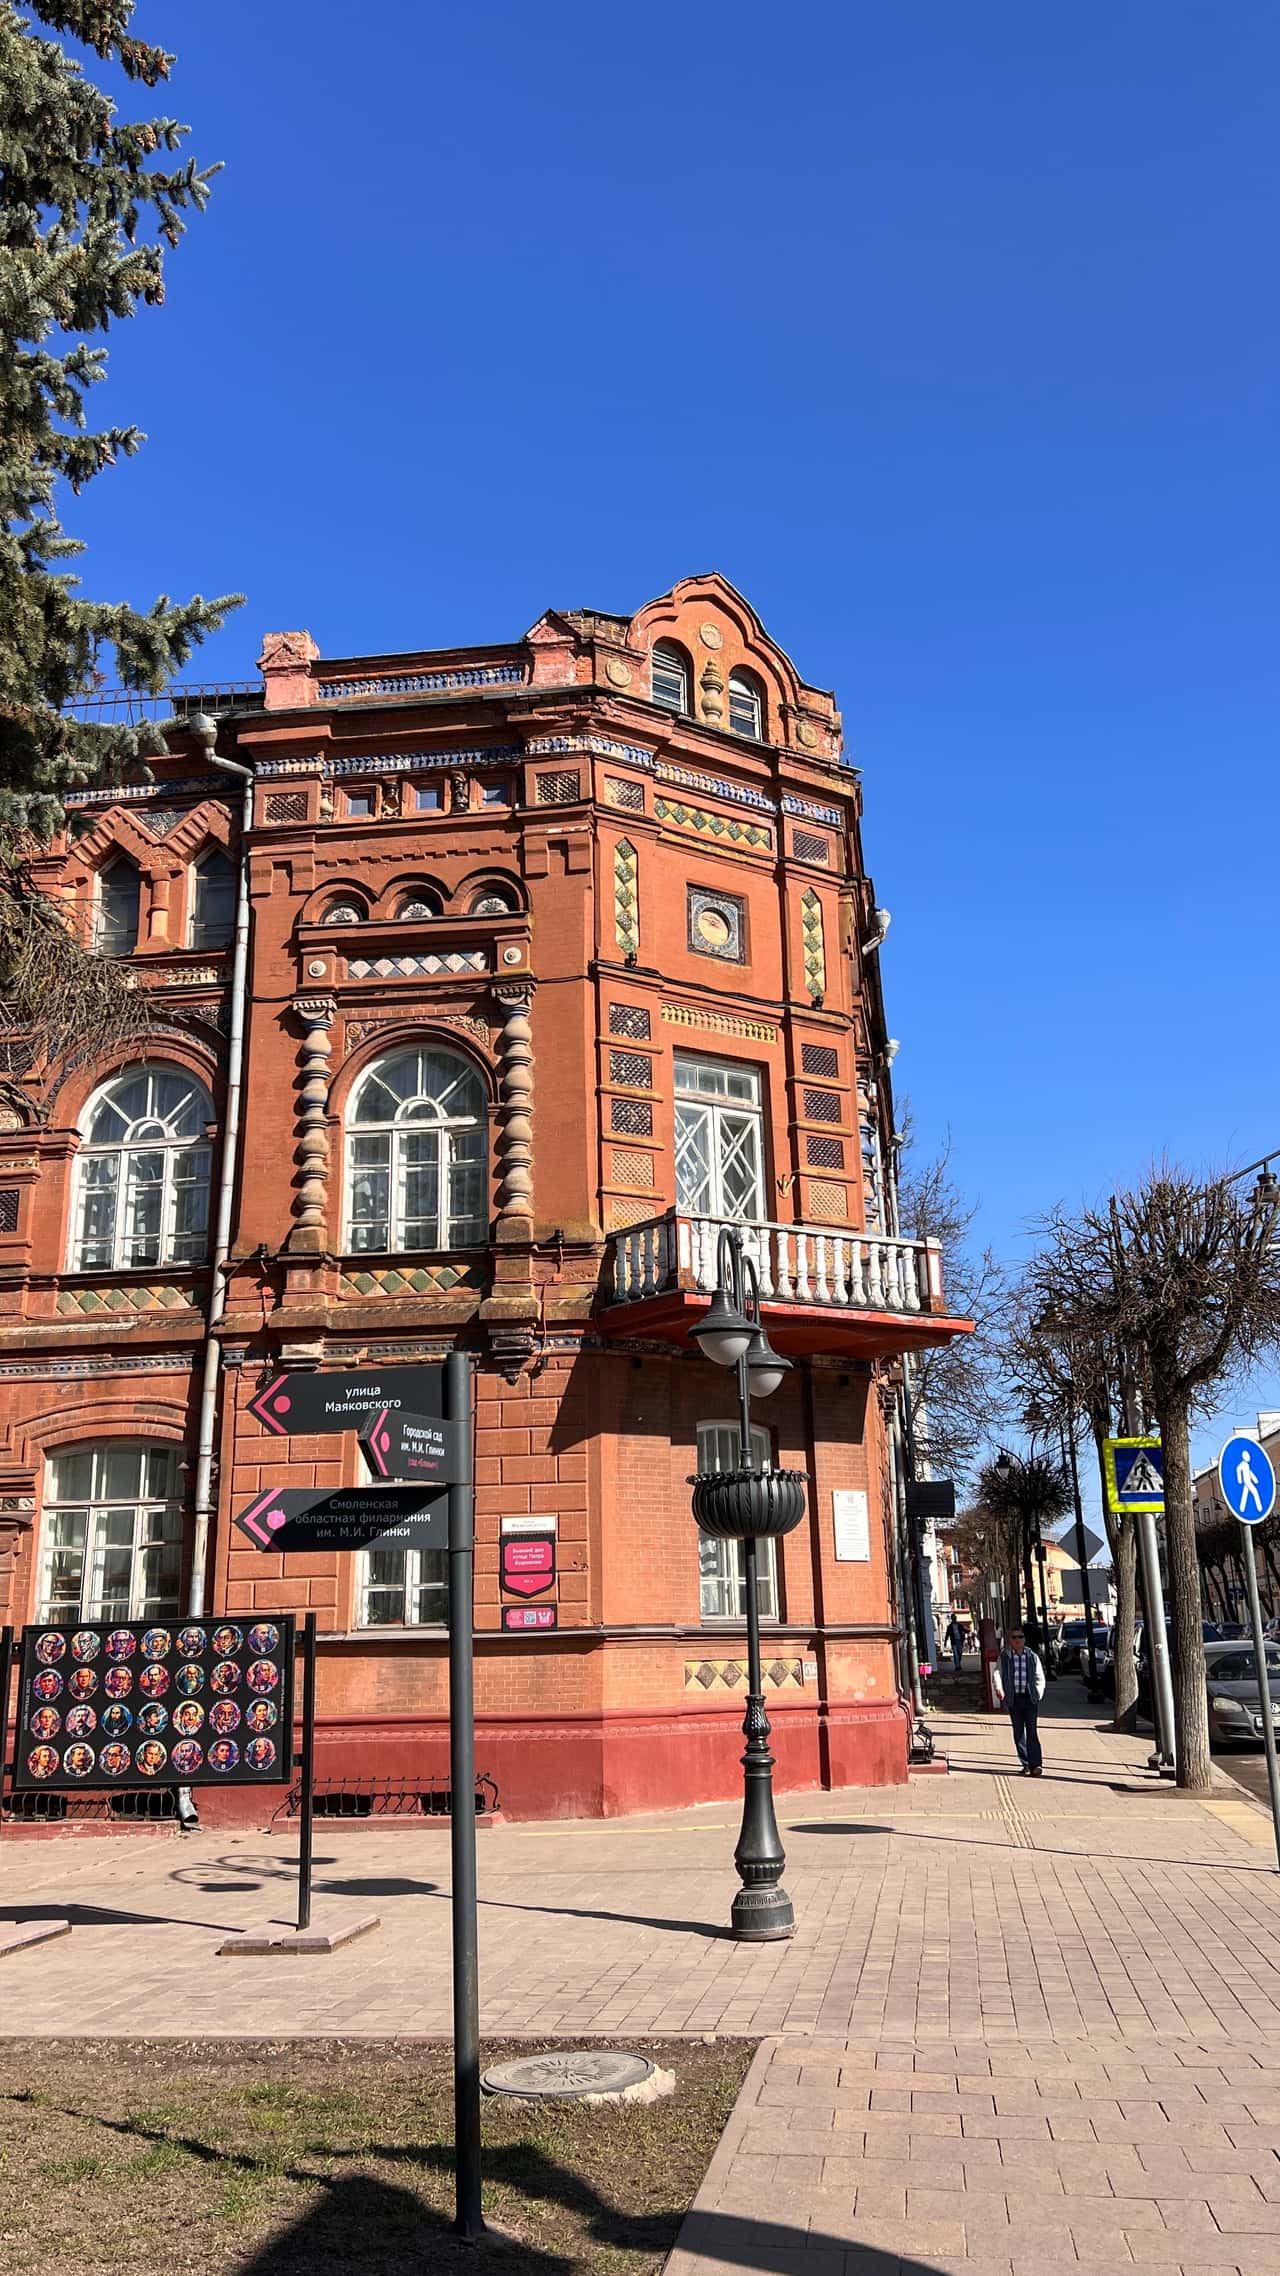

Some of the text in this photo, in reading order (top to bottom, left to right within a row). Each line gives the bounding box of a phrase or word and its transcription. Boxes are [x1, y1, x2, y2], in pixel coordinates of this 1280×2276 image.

[345, 1386, 381, 1399] улица
[325, 1399, 401, 1413] Маяковского
[403, 1424, 432, 1440] Городской
[329, 1499, 399, 1510] Смоленская
[295, 1512, 431, 1525] областная филармония
[316, 1526, 411, 1538] им. М.И. Глинки
